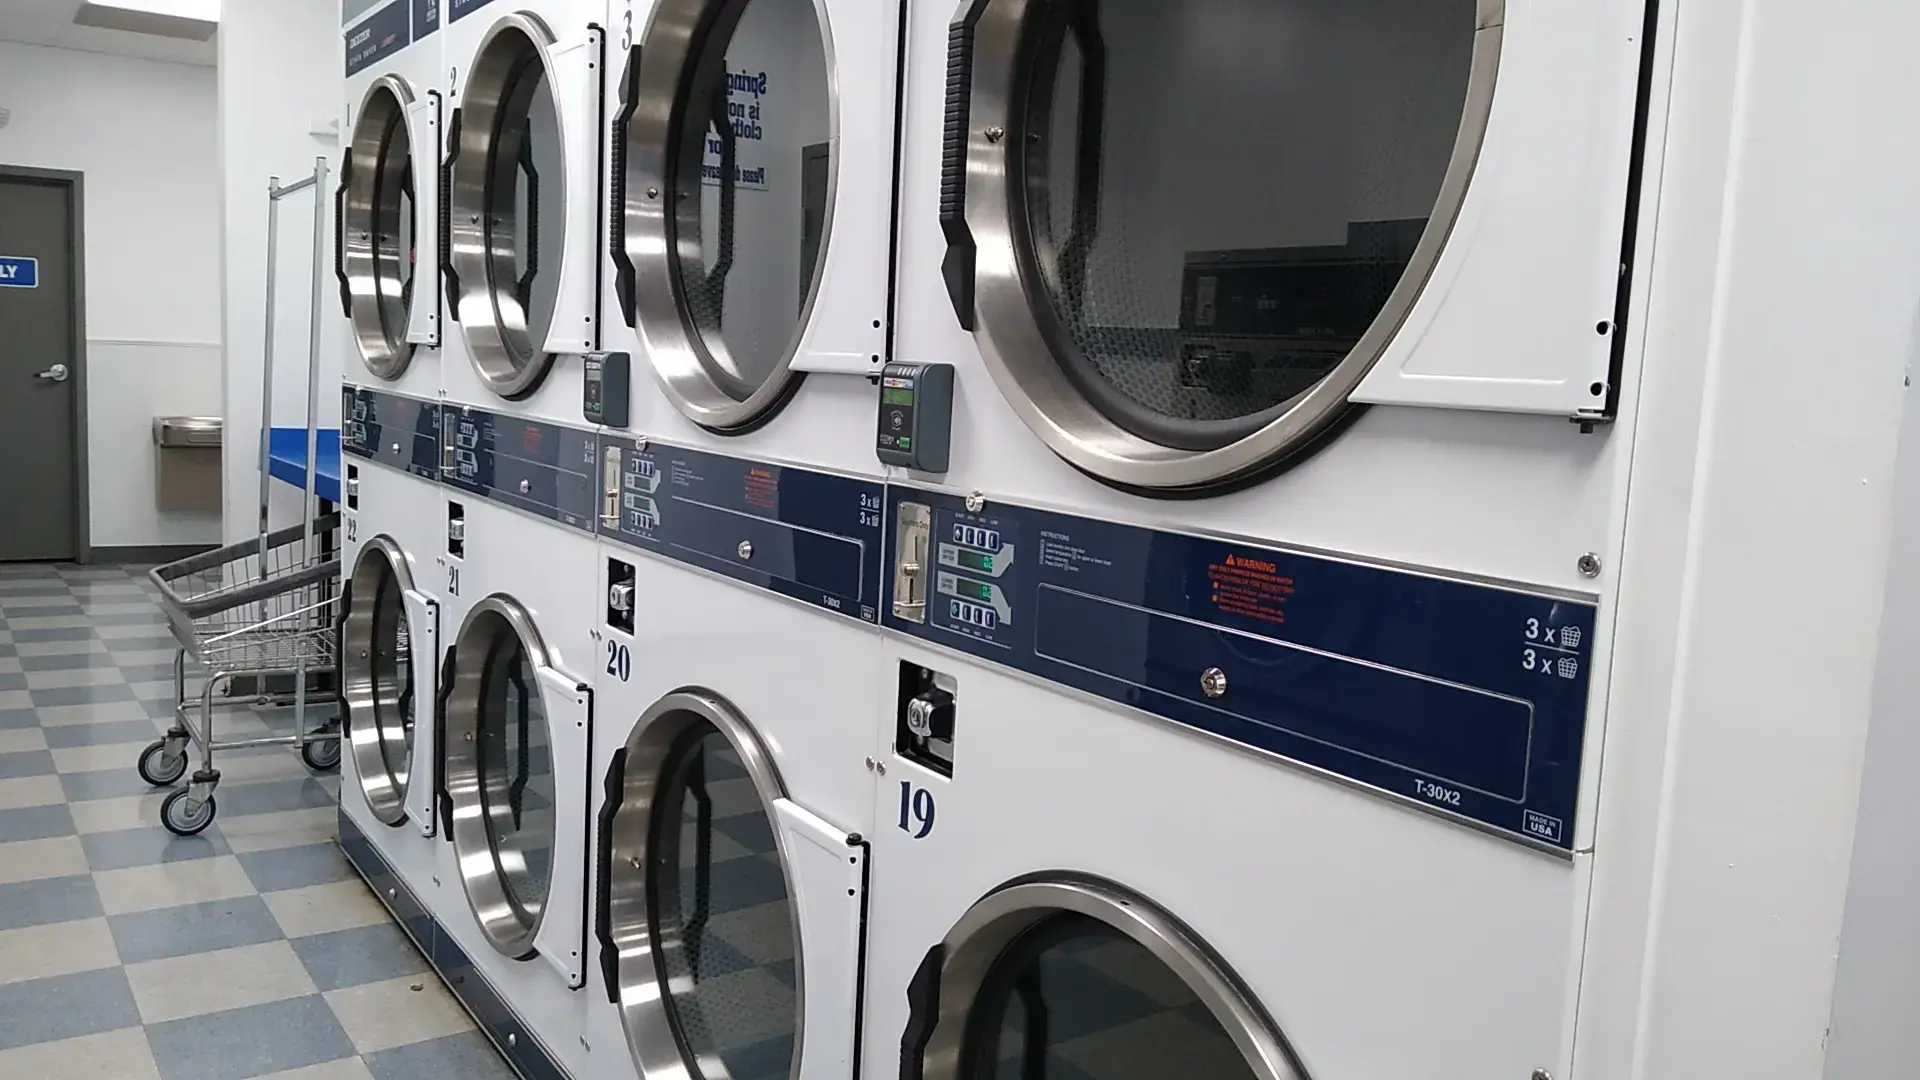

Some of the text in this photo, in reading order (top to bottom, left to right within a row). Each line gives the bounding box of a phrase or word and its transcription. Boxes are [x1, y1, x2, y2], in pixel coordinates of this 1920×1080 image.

[622, 10, 631, 50] 3
[450, 66, 457, 98] 2
[860, 493, 866, 506] 3
[859, 511, 865, 524] 3
[348, 517, 357, 543] 22
[1237, 557, 1277, 573] WARNING
[448, 565, 459, 597] 21
[1525, 617, 1539, 639] 3
[607, 639, 630, 682] 20
[1522, 648, 1536, 670] 3
[1414, 779, 1461, 806] T-30X2
[898, 780, 935, 839] 19
[1529, 814, 1557, 828] MADE IN
[1530, 821, 1553, 836] USA
